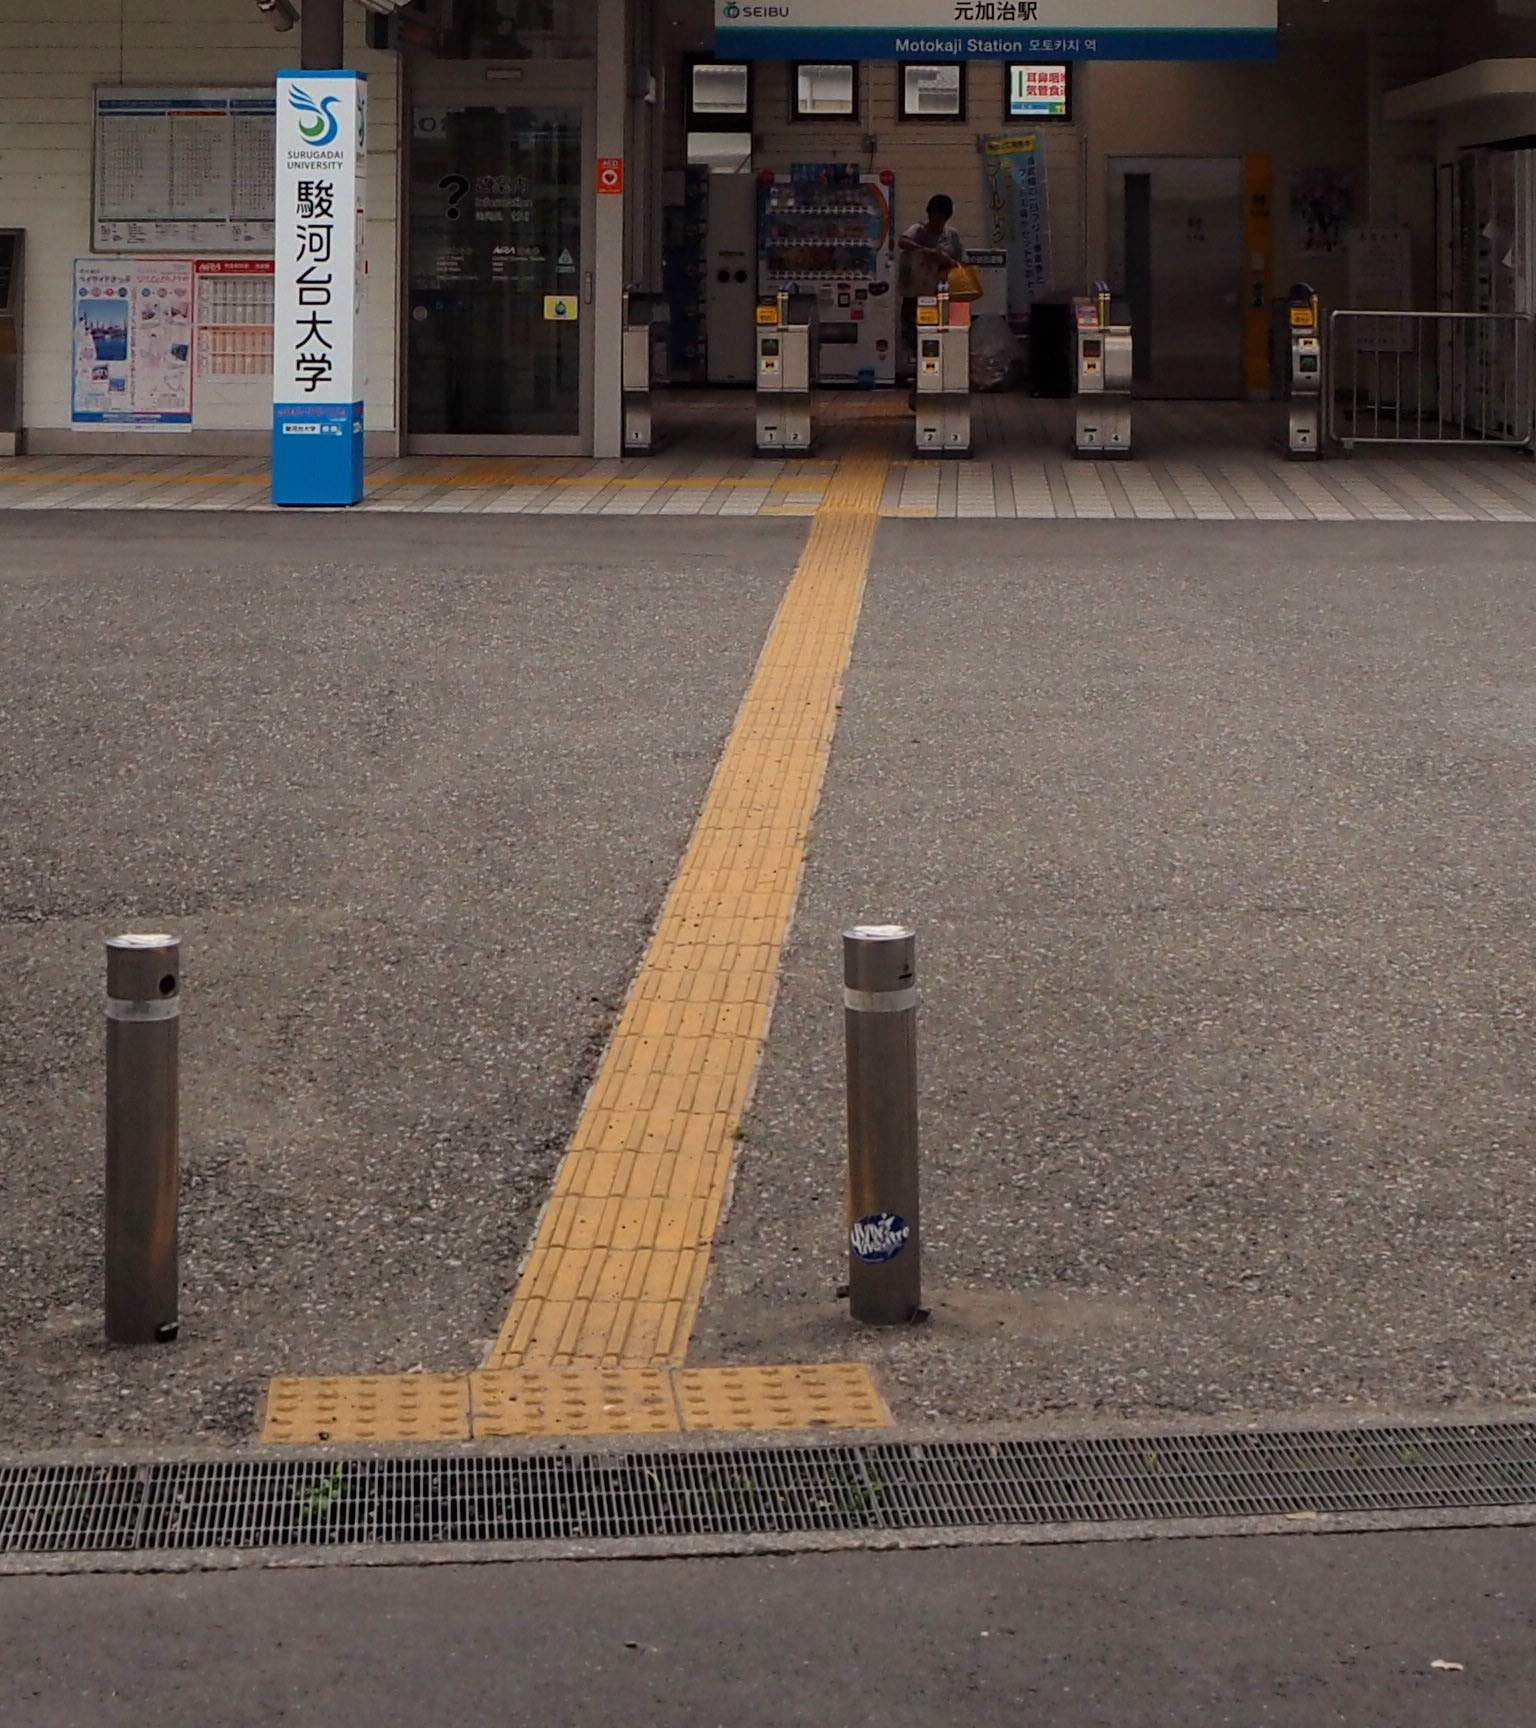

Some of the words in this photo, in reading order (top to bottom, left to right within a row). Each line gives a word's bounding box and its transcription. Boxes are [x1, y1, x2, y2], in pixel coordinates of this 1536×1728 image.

[743, 7, 790, 18] SEIBU
[954, 2, 1038, 21] 元加治駅
[895, 39, 962, 55] Motokaji
[966, 39, 1023, 53] Station
[1028, 39, 1080, 53] 모토카지
[1084, 39, 1097, 53] 역
[287, 151, 344, 159] SURUGADAI
[287, 161, 344, 170] UNIVERSITY
[294, 178, 334, 393] 駿河台大学
